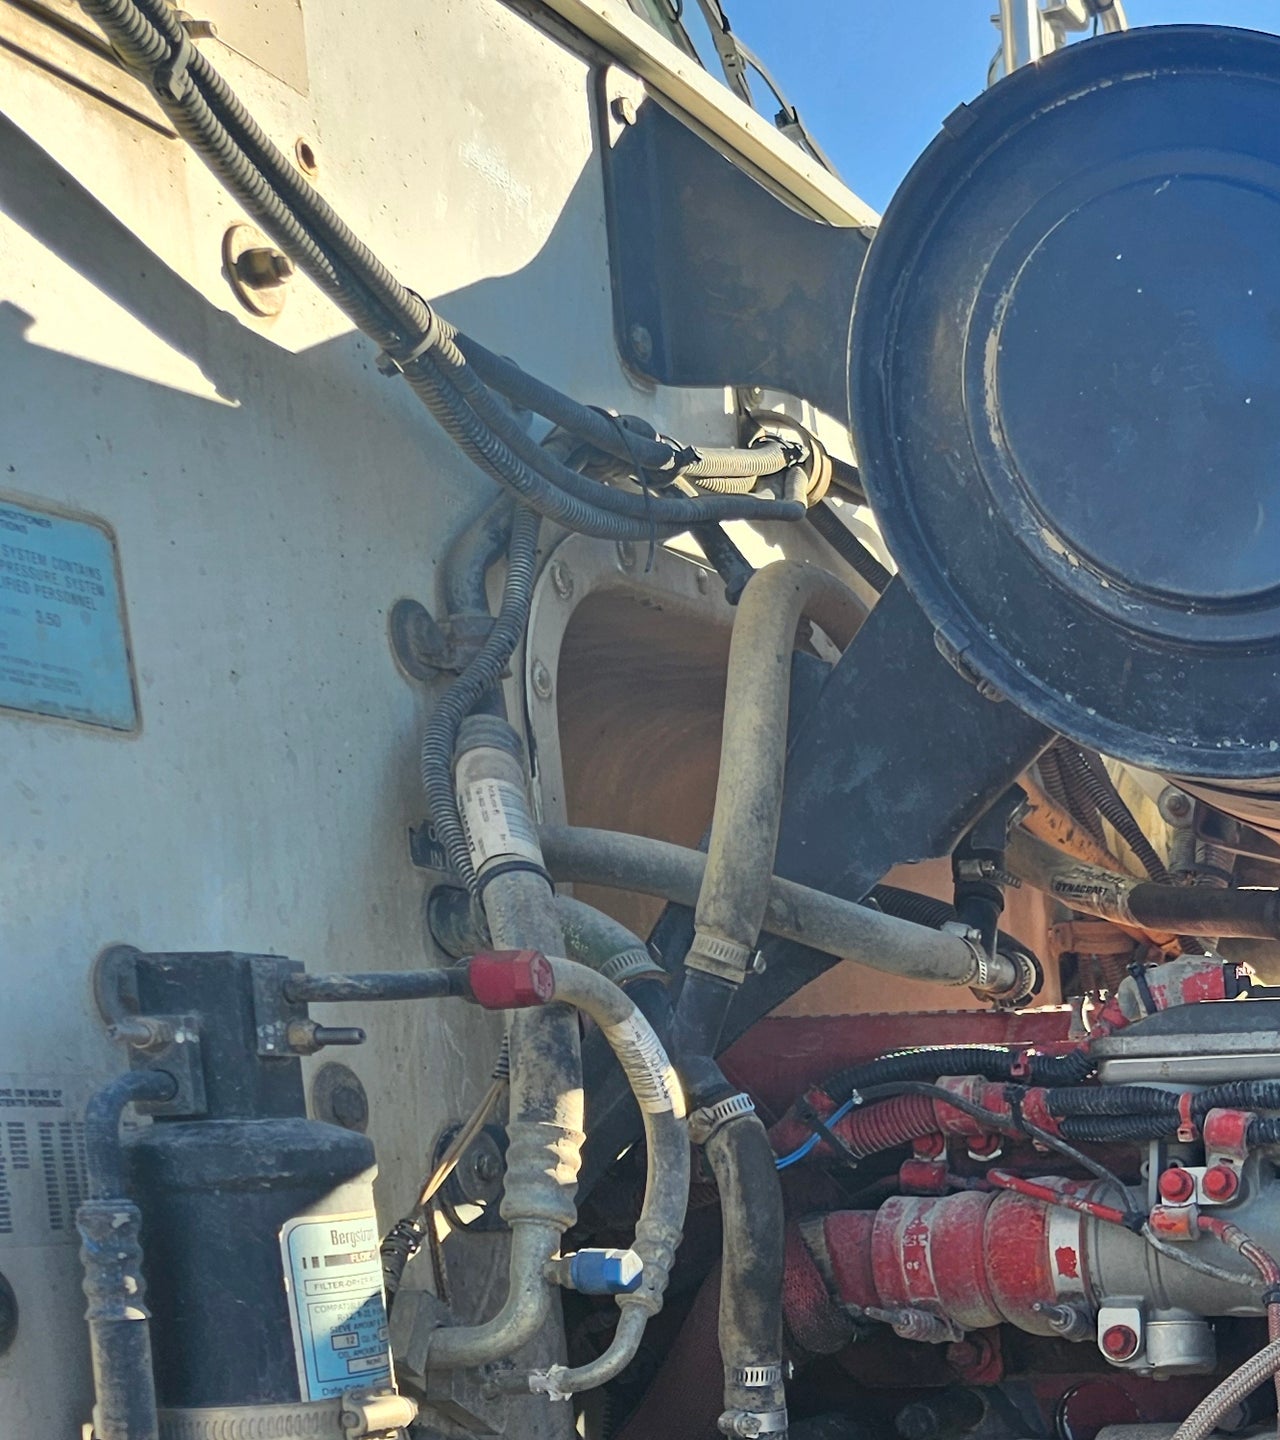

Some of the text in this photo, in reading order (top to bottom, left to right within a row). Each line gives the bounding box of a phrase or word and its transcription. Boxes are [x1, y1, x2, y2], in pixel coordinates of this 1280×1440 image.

[1, 543, 103, 581] SYSTEM CONTAINS
[34, 583, 98, 612] PERSONNEL
[64, 575, 105, 598] SYSTEM
